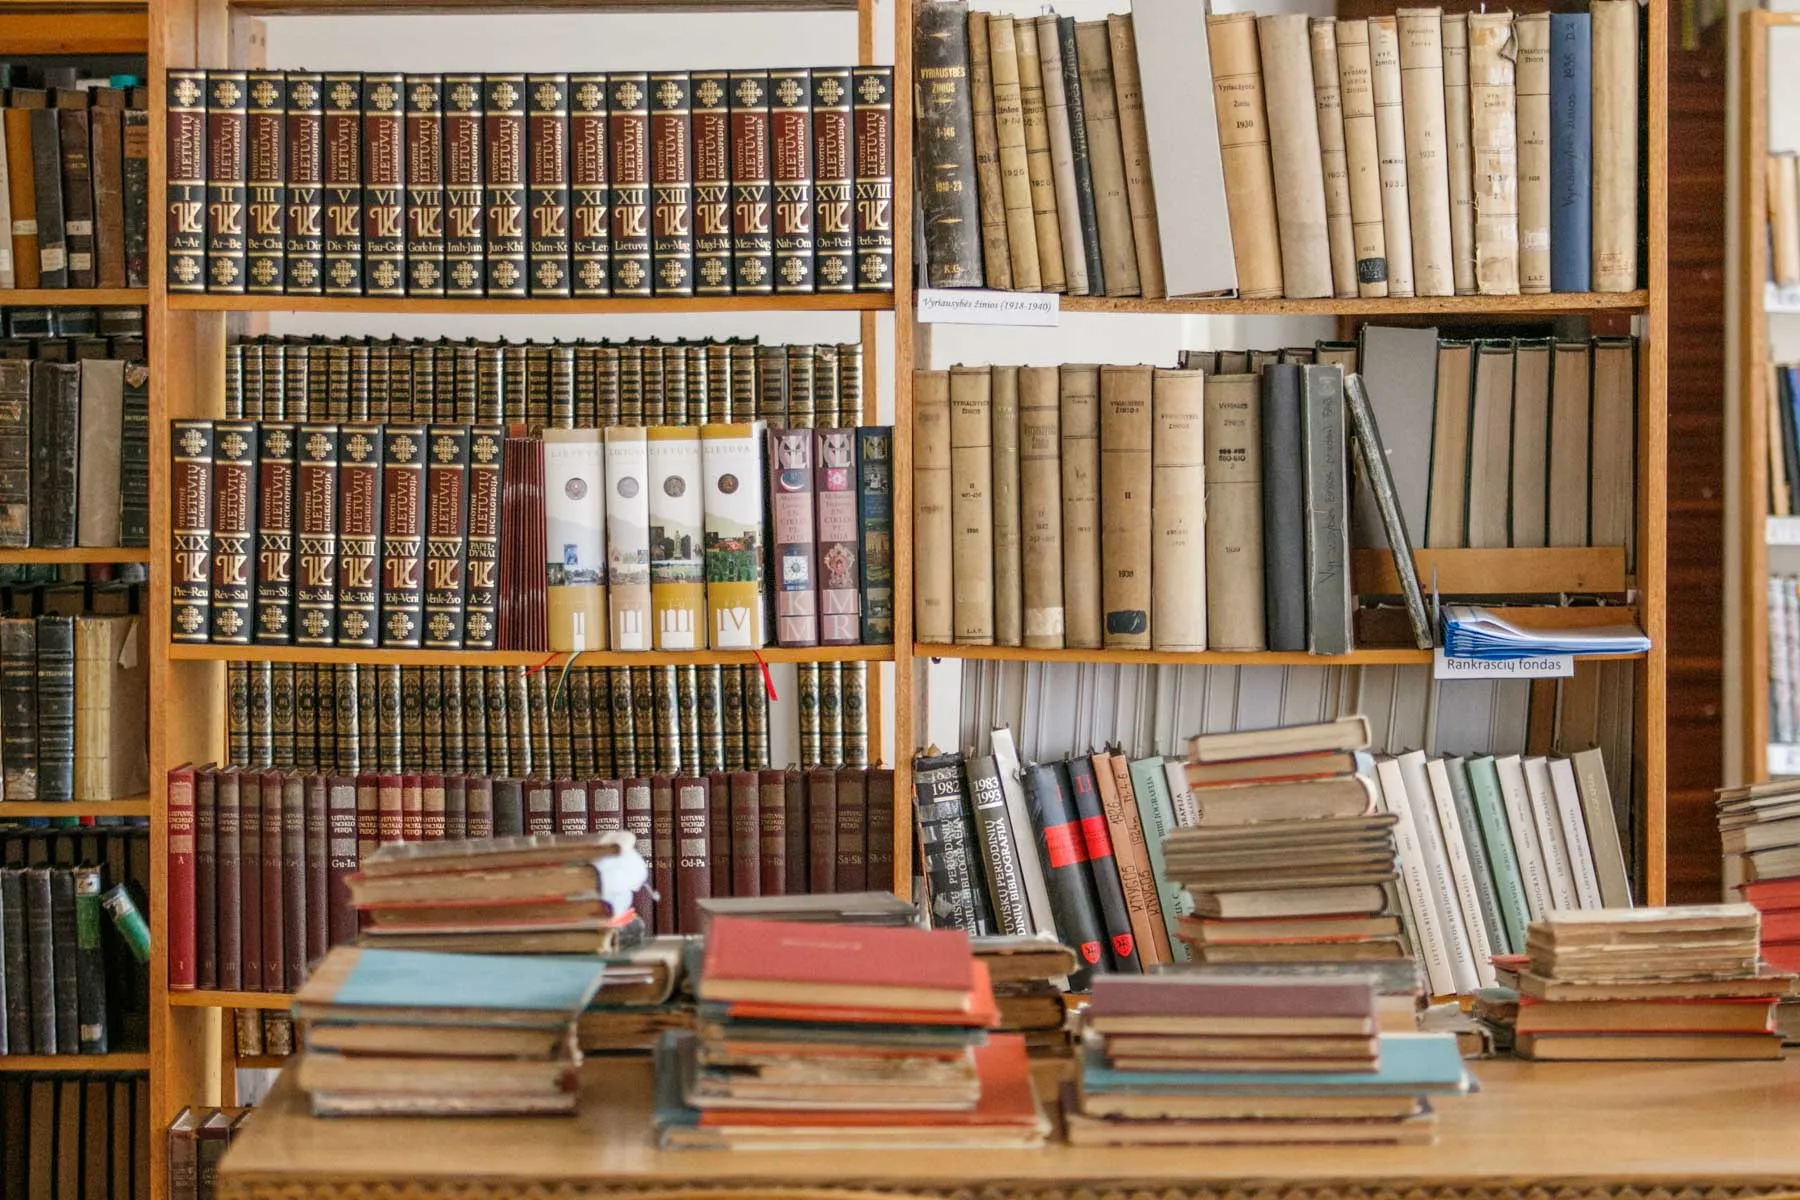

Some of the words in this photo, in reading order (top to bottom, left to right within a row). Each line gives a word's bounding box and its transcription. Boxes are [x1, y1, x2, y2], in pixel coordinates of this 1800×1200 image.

[1236, 120, 1253, 128] 1930
[184, 186, 190, 200] I
[221, 187, 233, 202] II
[256, 187, 275, 202] III
[294, 189, 315, 203] IV
[337, 189, 351, 203] V
[375, 190, 395, 204] VI
[412, 191, 440, 205] VII
[448, 191, 481, 205] VIII
[495, 190, 516, 205] IX
[541, 191, 556, 205] X
[582, 190, 601, 205] XI
[617, 190, 644, 204] XII
[657, 189, 686, 204] XIII
[696, 187, 727, 201] XIV
[739, 187, 764, 201] XV
[777, 186, 808, 201] XVI
[816, 186, 851, 200] XVII
[856, 184, 891, 199] XVIII
[174, 237, 200, 247] A-Ar
[212, 239, 242, 249] Ar-Be
[248, 239, 282, 249] Be-Cha
[489, 242, 523, 253] Juo-Khi
[923, 298, 972, 310] Vyriausybės
[1000, 301, 1052, 313] (1918-1940)
[175, 536, 208, 550] XIX
[219, 538, 245, 553] XX
[261, 535, 291, 550] XXI
[300, 539, 335, 554] XXII
[341, 541, 376, 556] XXIII
[385, 542, 420, 556] XXIV
[427, 542, 462, 557] XXV
[1519, 657, 1561, 670] fondas
[932, 781, 960, 796] 1982
[974, 777, 1000, 792] 1983
[977, 790, 1001, 805] 1993
[178, 856, 184, 864] A
[985, 820, 1006, 887] PERIODINIŲ
[995, 817, 1019, 903] BIBLIOGRAFIJA
[332, 860, 356, 868] Gu-In
[681, 859, 705, 867] Od-Pa
